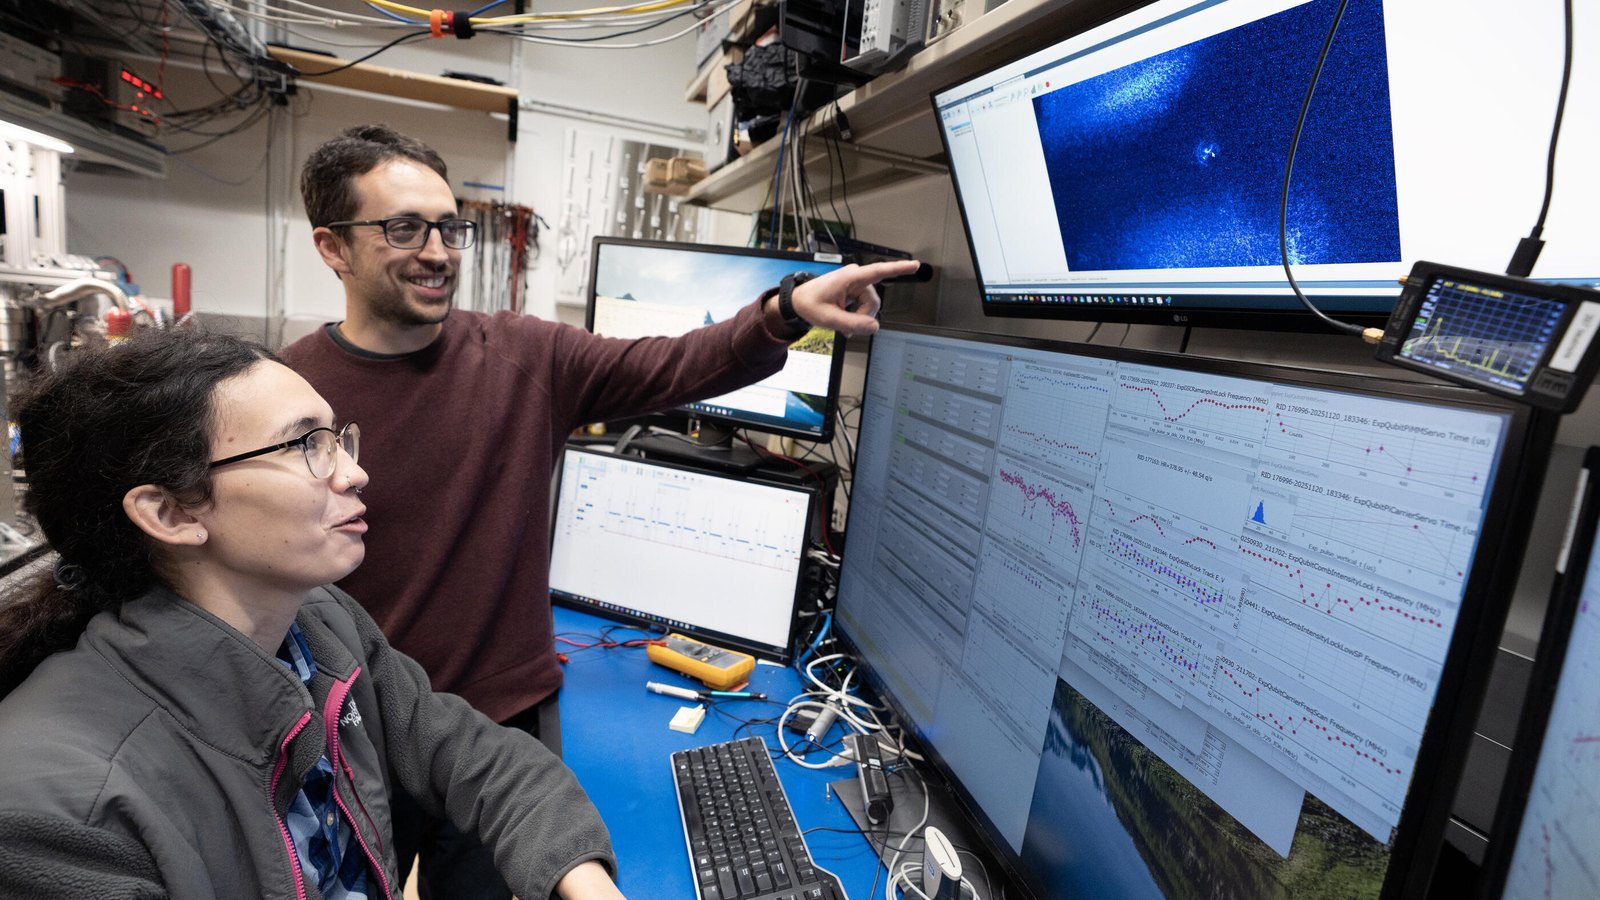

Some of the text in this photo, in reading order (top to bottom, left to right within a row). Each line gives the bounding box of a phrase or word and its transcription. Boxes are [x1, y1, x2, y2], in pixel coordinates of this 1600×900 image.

[1228, 393, 1252, 402] Frequency
[1252, 396, 1269, 405] (MHz)
[1372, 420, 1446, 438] ExpQubitPiMMServo
[1448, 432, 1470, 443] Time
[1472, 436, 1490, 448] (us)
[1353, 496, 1437, 525] ExpQubitPiCarrierServo
[1440, 520, 1461, 532] Time
[1202, 569, 1215, 578] Track
[1288, 553, 1374, 591] ExpQubitCombIntensityLock
[1376, 586, 1414, 607] Frequency
[1416, 601, 1442, 617] (MHz)
[1180, 632, 1192, 644] Track
[1244, 599, 1427, 691] 0441: ExpQubitCombIntensityLockLowSP Frequency (MHz)
[1258, 677, 1328, 722] ExpQubitCarrierFreqScan
[1329, 719, 1364, 743] Frequency
[1365, 739, 1388, 757] (MHz)
